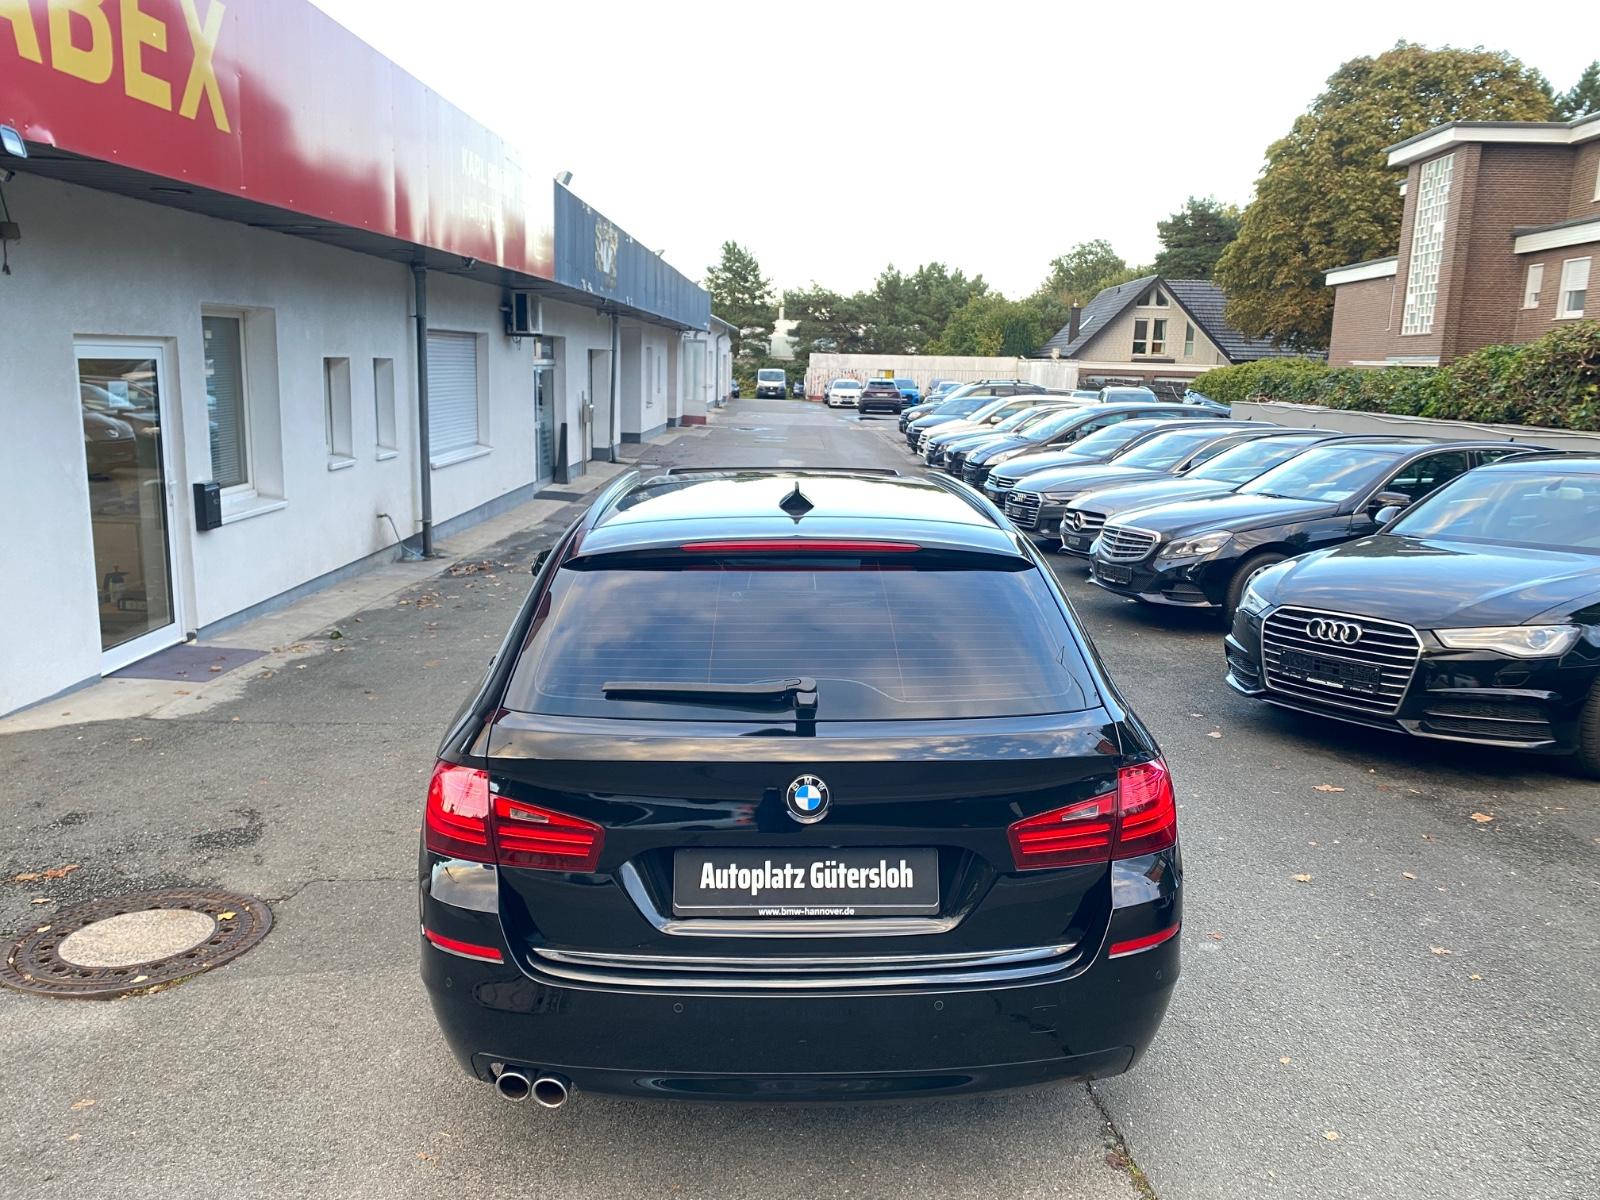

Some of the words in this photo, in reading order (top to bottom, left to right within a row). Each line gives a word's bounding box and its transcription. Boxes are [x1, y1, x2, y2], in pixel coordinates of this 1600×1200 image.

[791, 776, 826, 791] BMW
[700, 860, 805, 896] Autoplatz
[810, 859, 914, 889] Gütersloh
[758, 906, 855, 916] www.bmw-hannover.de
